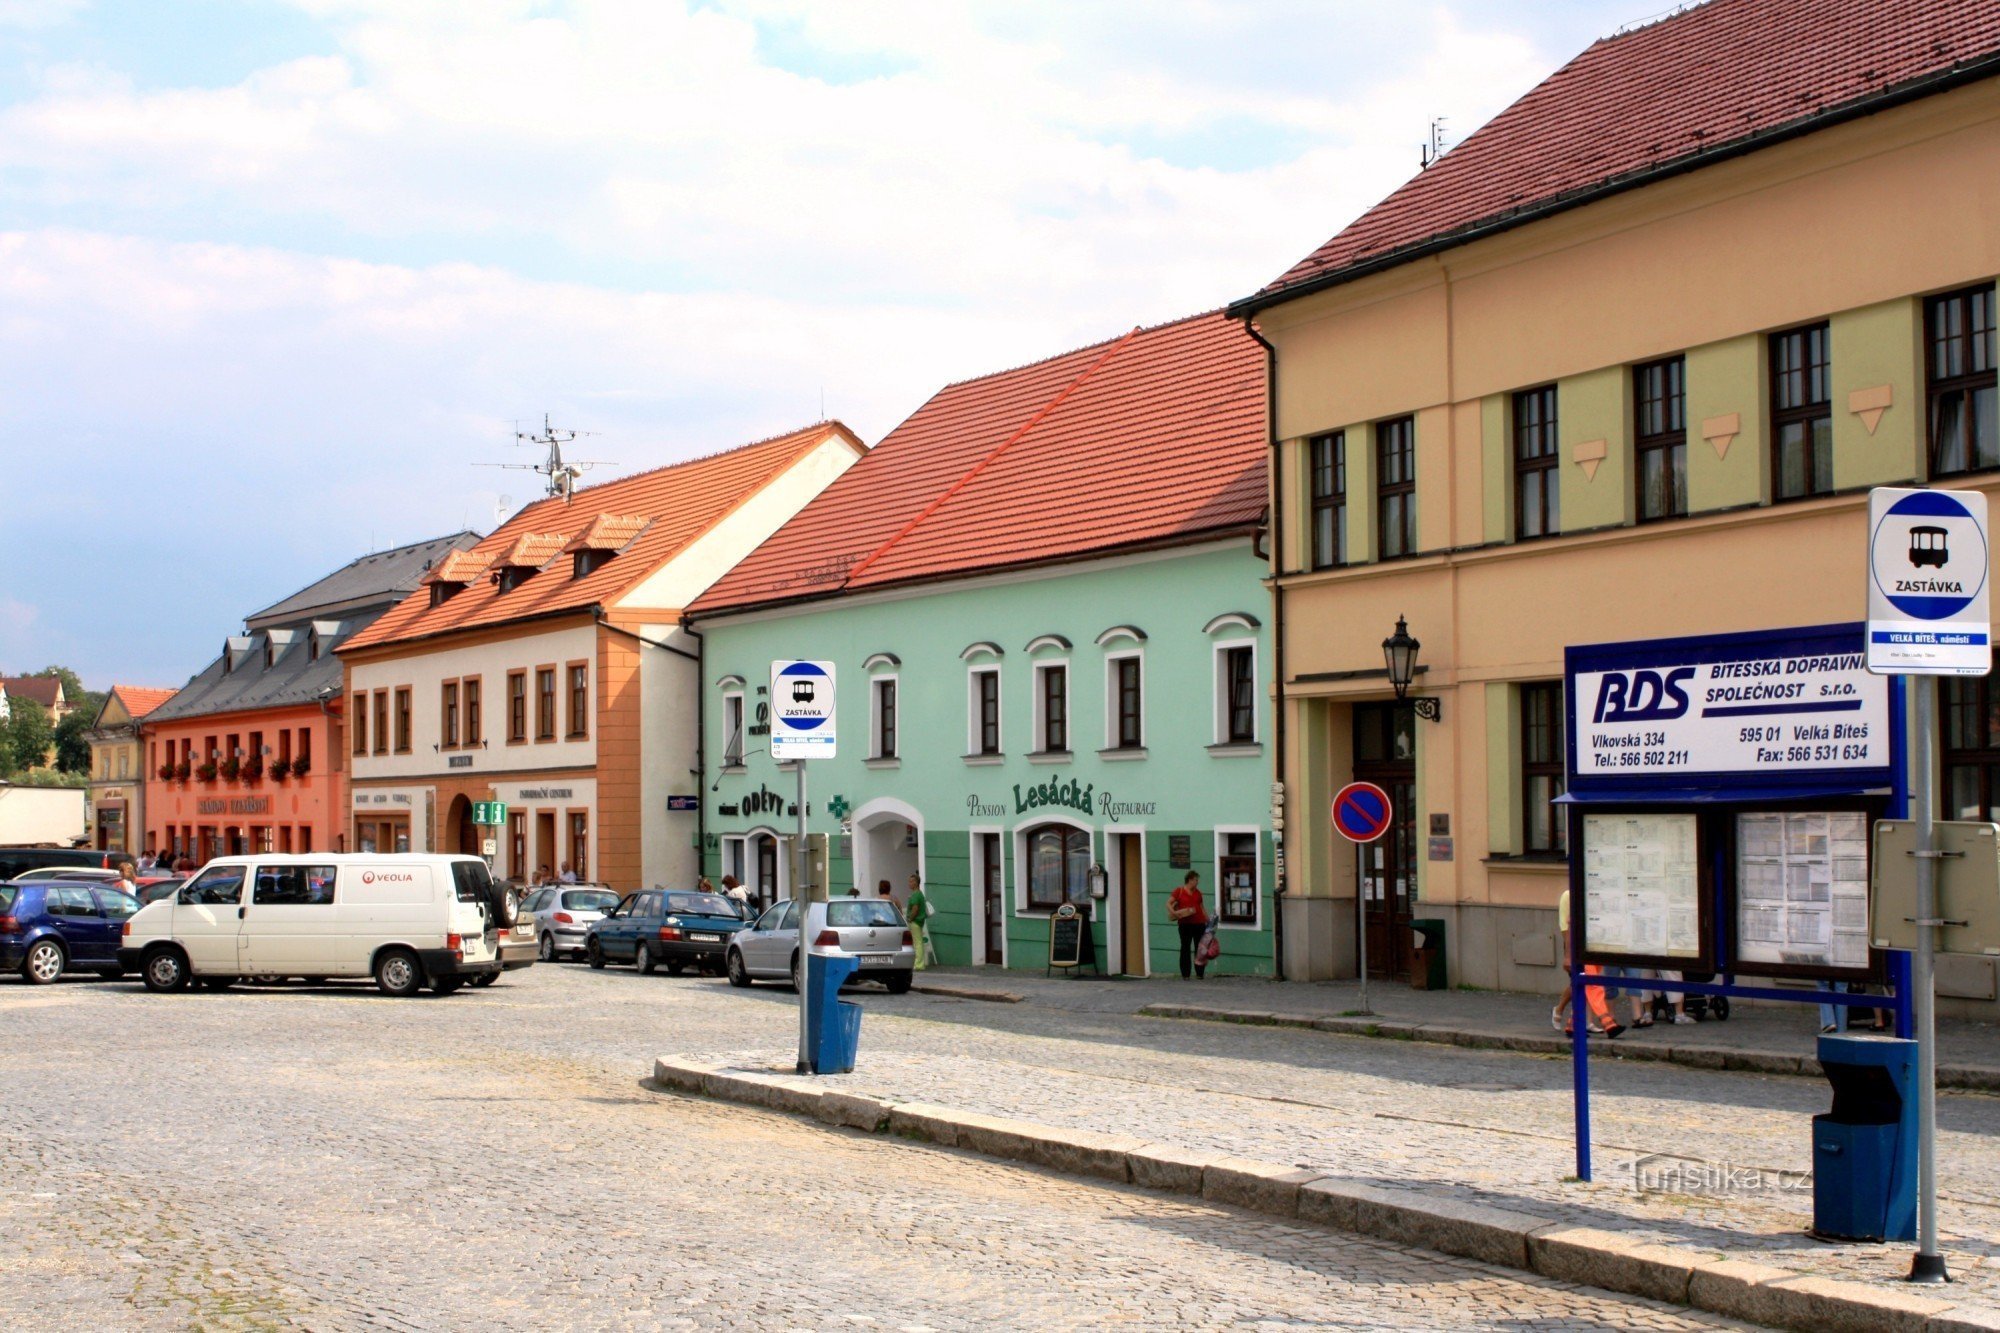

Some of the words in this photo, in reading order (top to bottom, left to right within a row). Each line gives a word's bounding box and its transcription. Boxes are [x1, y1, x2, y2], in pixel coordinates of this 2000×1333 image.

[1895, 577, 1963, 593] ZASTÁVKA
[1889, 633, 1913, 643] VELKÁ
[1915, 632, 1939, 644] BÍTEŠ,
[1940, 634, 1970, 644] náměstí
[1592, 667, 1697, 724] BDS
[1705, 681, 1806, 703] SPOLEČNOST
[1819, 683, 1857, 697] s.r.o.
[785, 708, 822, 716] ZASTÁVKA
[1592, 732, 1641, 748] Vlkovská
[1643, 732, 1665, 747] 334
[1739, 727, 1763, 743] 595
[1765, 726, 1782, 742] 01
[1793, 725, 1830, 741] Velká
[1833, 723, 1869, 740] Bíteš
[1594, 753, 1617, 767] Tel.:
[1619, 752, 1641, 767] 566
[1643, 751, 1665, 766] 502
[1667, 750, 1689, 765] 211
[1756, 748, 1784, 763] Fax:
[1786, 747, 1811, 762] 566
[1814, 745, 1839, 761] 531
[1842, 744, 1868, 760] 634
[741, 783, 784, 817] ODĚVY
[1012, 774, 1094, 816] Lesácká
[376, 874, 413, 882] VEOLIA
